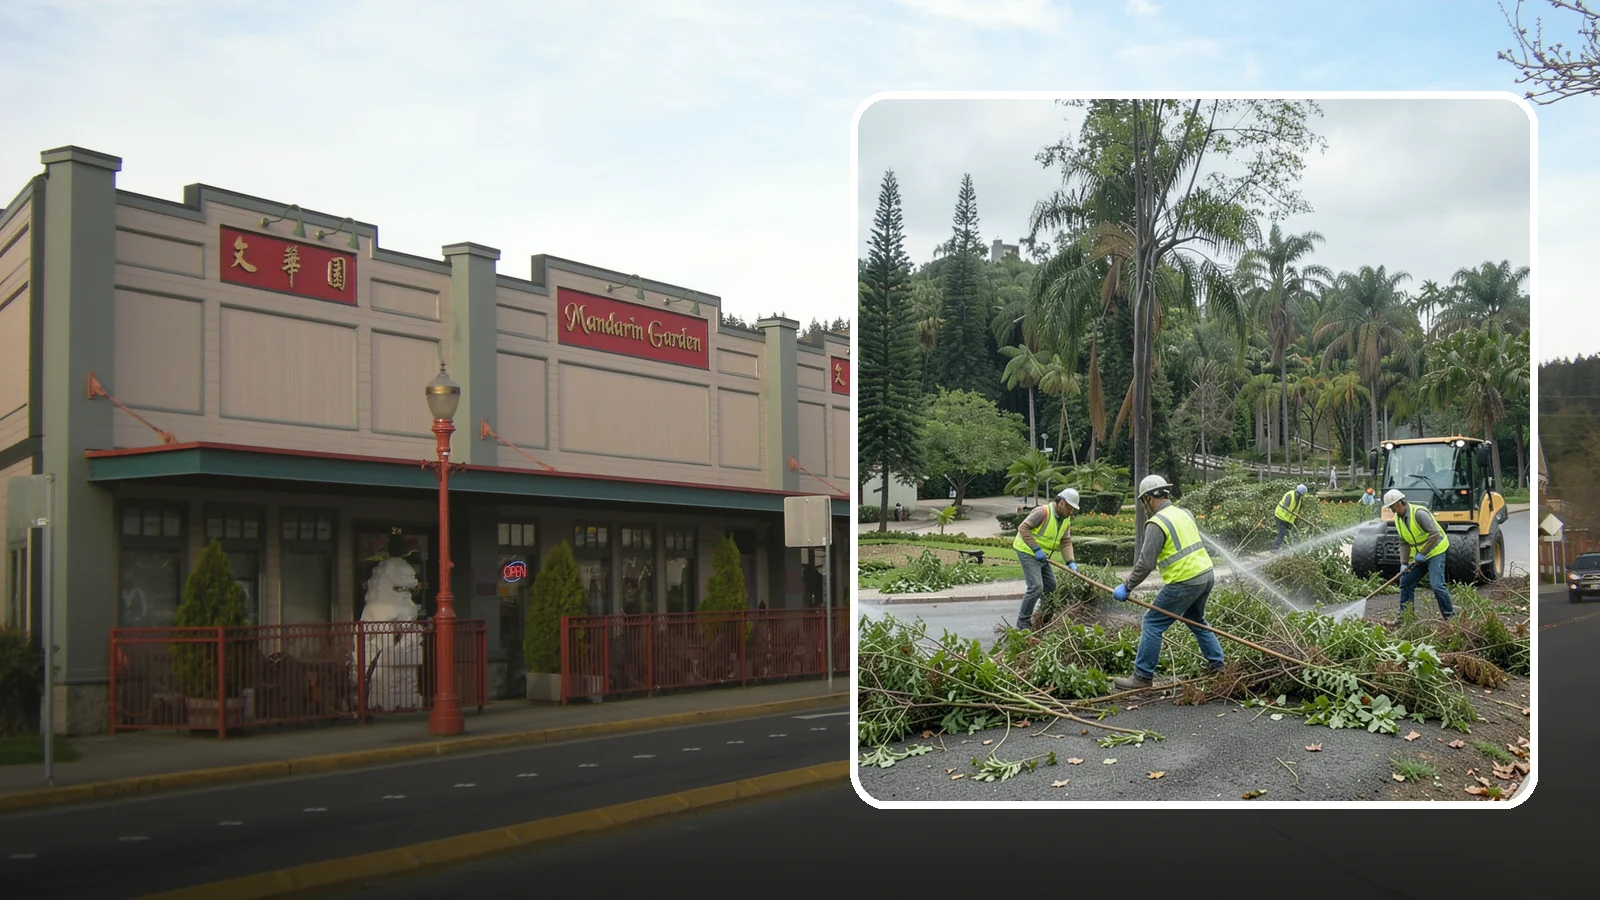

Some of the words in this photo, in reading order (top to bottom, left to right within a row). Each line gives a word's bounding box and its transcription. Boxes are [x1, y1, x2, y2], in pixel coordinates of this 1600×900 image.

[231, 235, 347, 291] 文華園
[564, 302, 644, 341] Mandarin
[648, 320, 702, 352] Garden
[503, 565, 527, 578] OPEN
